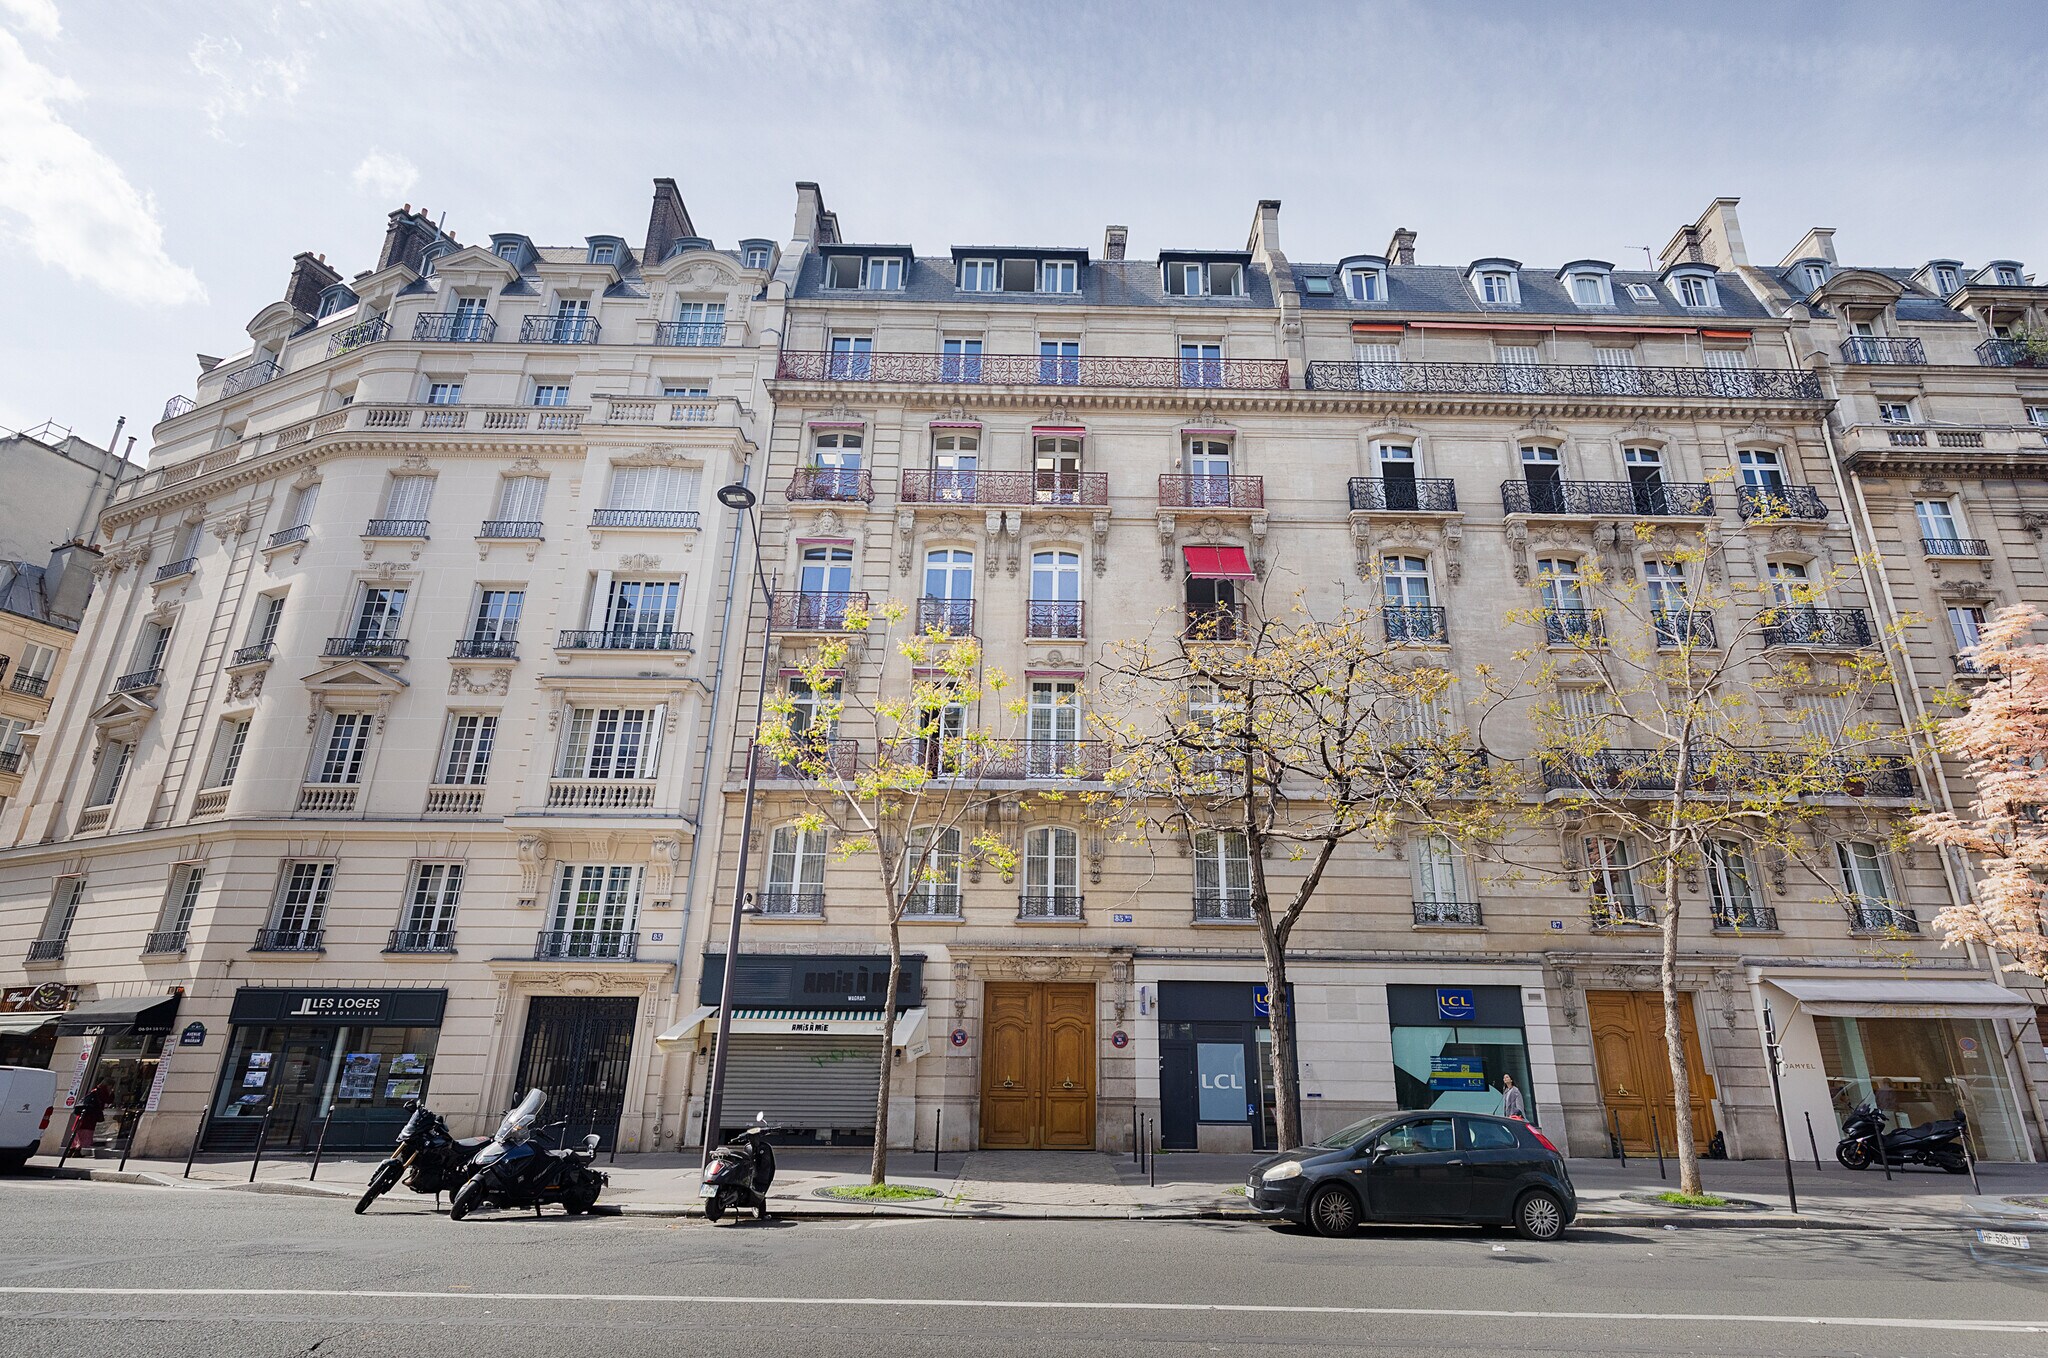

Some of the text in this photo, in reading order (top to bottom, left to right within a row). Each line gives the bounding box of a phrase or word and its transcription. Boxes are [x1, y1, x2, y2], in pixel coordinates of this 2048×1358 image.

[312, 998, 381, 1009] LES LOGES
[1441, 996, 1471, 1007] LCL
[1201, 1074, 1243, 1089] LCL
